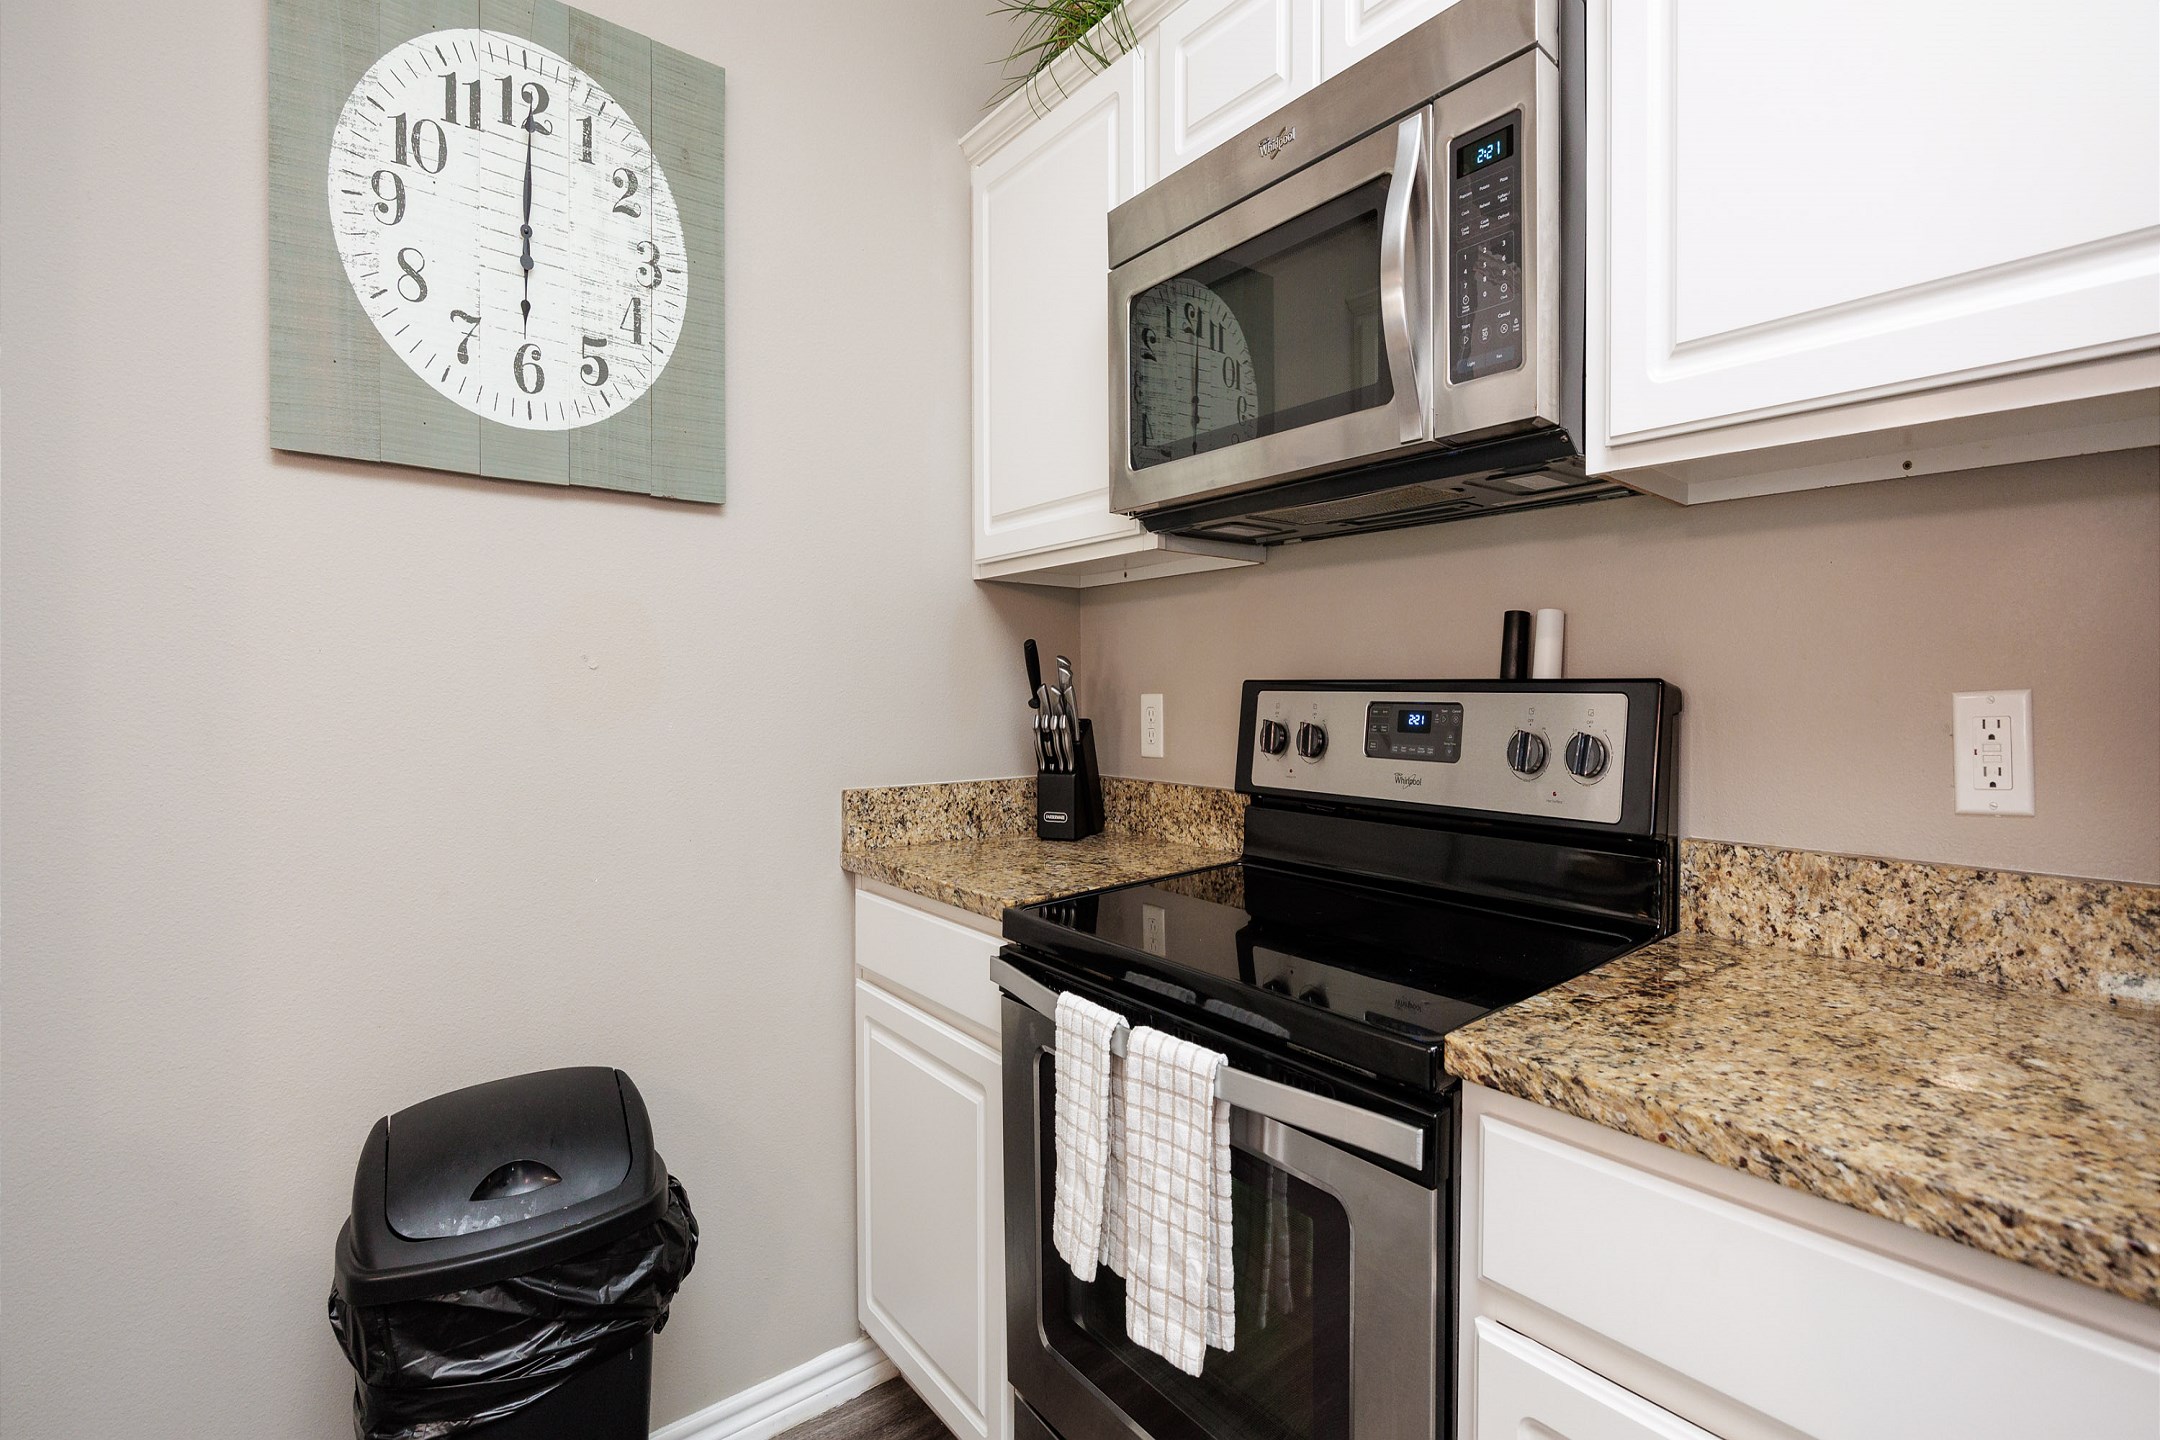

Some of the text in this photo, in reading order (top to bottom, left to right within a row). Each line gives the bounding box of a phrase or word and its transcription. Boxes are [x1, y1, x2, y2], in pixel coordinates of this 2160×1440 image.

[438, 71, 485, 131] 11
[495, 75, 552, 136] 12
[387, 112, 447, 174] 10
[577, 115, 595, 165] 1
[1258, 126, 1296, 160] Whirlpool
[1476, 140, 1500, 164] 2:21
[371, 170, 406, 226] 9
[612, 168, 642, 218] 2
[397, 247, 428, 302] 8
[636, 241, 662, 289] 3
[450, 310, 481, 365] 7
[620, 297, 642, 345] 4
[513, 343, 545, 394] 6
[580, 336, 609, 387] 5
[1408, 714, 1425, 726] 2:21
[1394, 772, 1422, 790] Whirlpool
